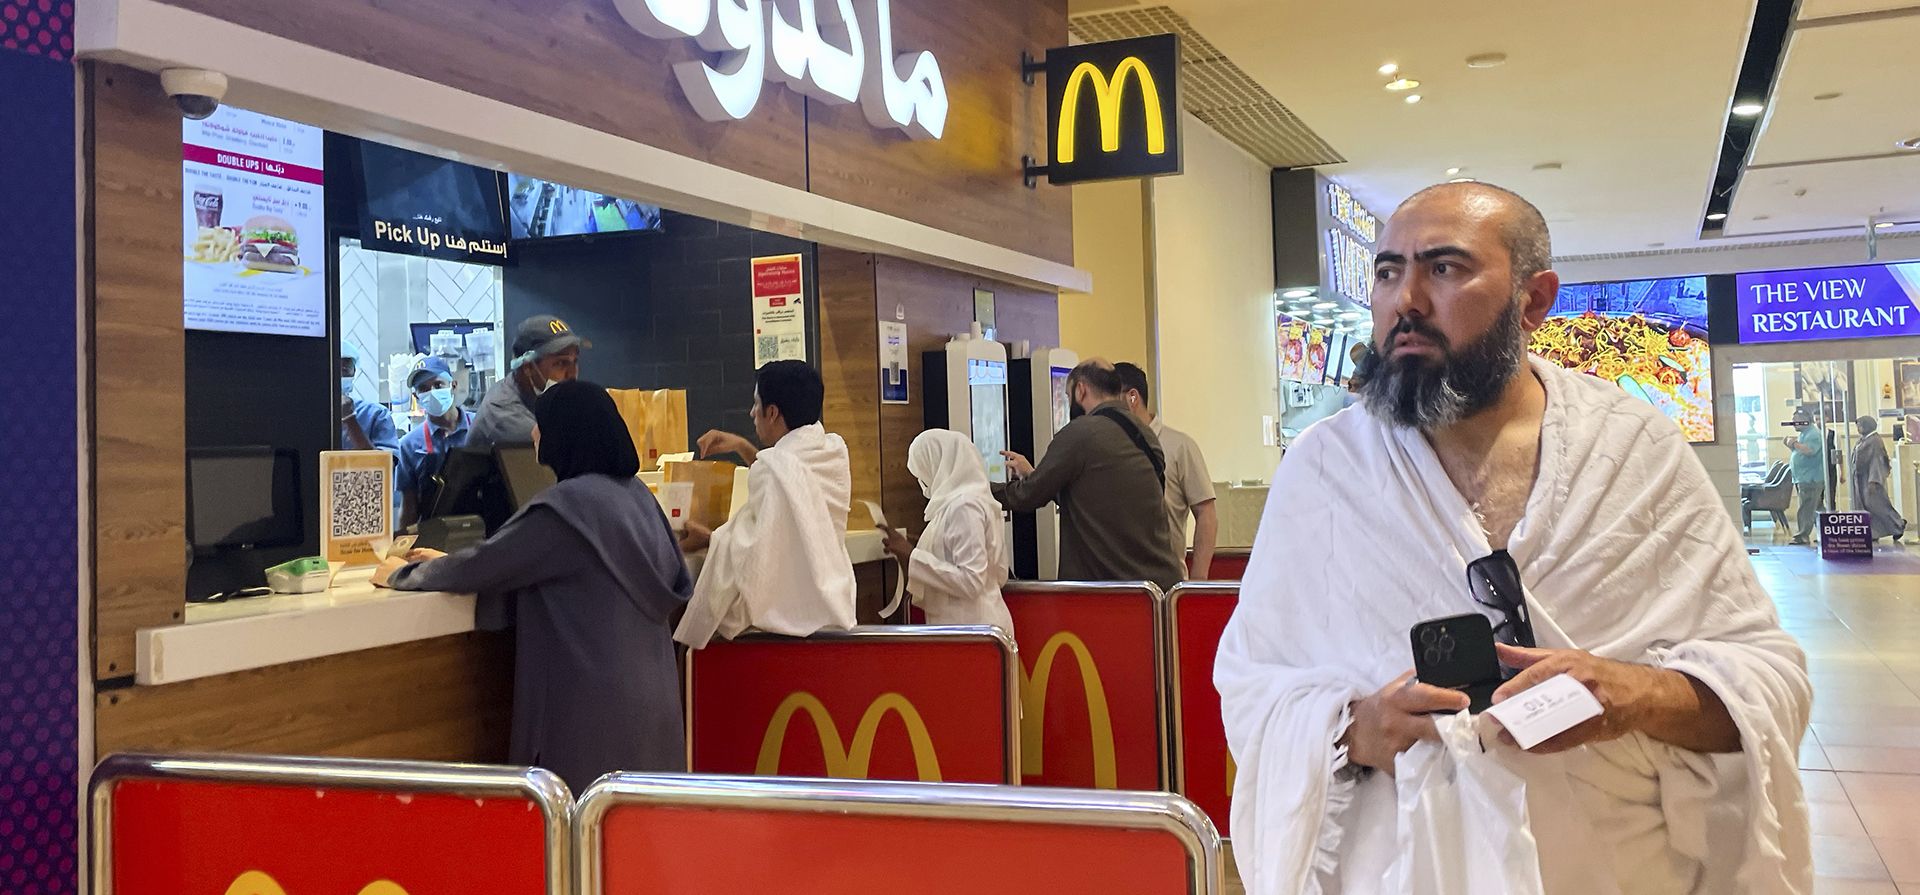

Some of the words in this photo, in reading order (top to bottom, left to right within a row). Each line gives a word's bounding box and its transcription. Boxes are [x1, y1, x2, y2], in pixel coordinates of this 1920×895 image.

[217, 153, 244, 168] DOUBLE
[245, 159, 259, 170] UPS
[374, 220, 414, 244] Pick
[416, 226, 441, 250] Up
[445, 233, 467, 250] هنا
[468, 239, 508, 258] إستلم
[1750, 282, 1799, 304] THE
[1803, 278, 1866, 301] VIEW
[1751, 305, 1910, 333] RESTAURANT
[1828, 514, 1863, 524] OPEN
[1824, 525, 1869, 535] BUFFET
